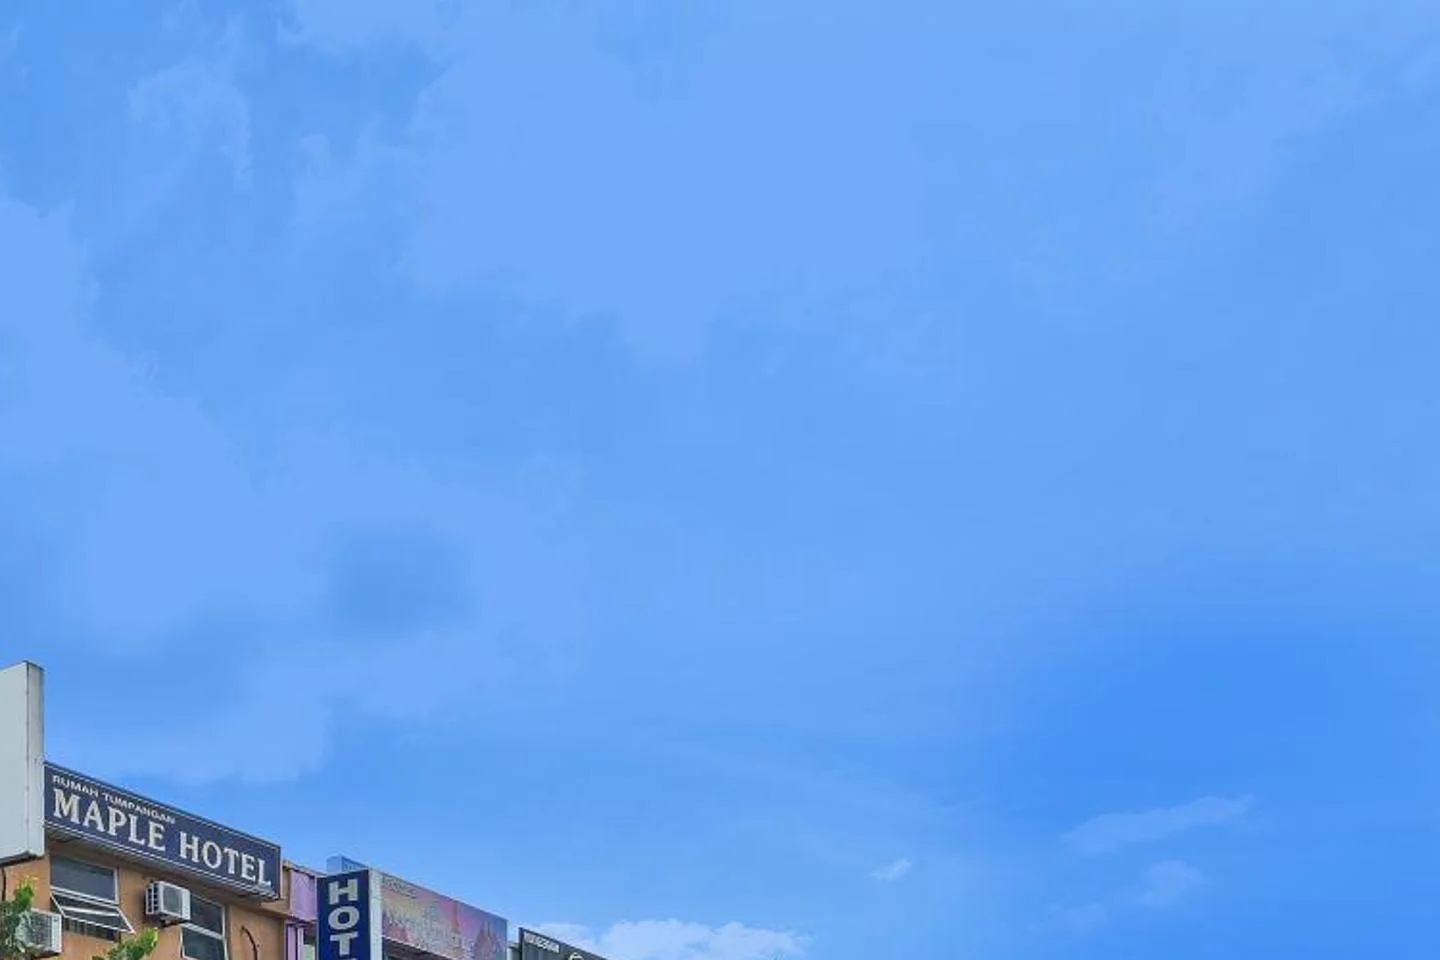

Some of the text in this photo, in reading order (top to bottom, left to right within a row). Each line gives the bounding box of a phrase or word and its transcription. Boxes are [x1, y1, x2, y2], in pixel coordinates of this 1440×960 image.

[52, 775, 99, 798] RUMAH
[53, 787, 272, 887] MAPLE HOTEL
